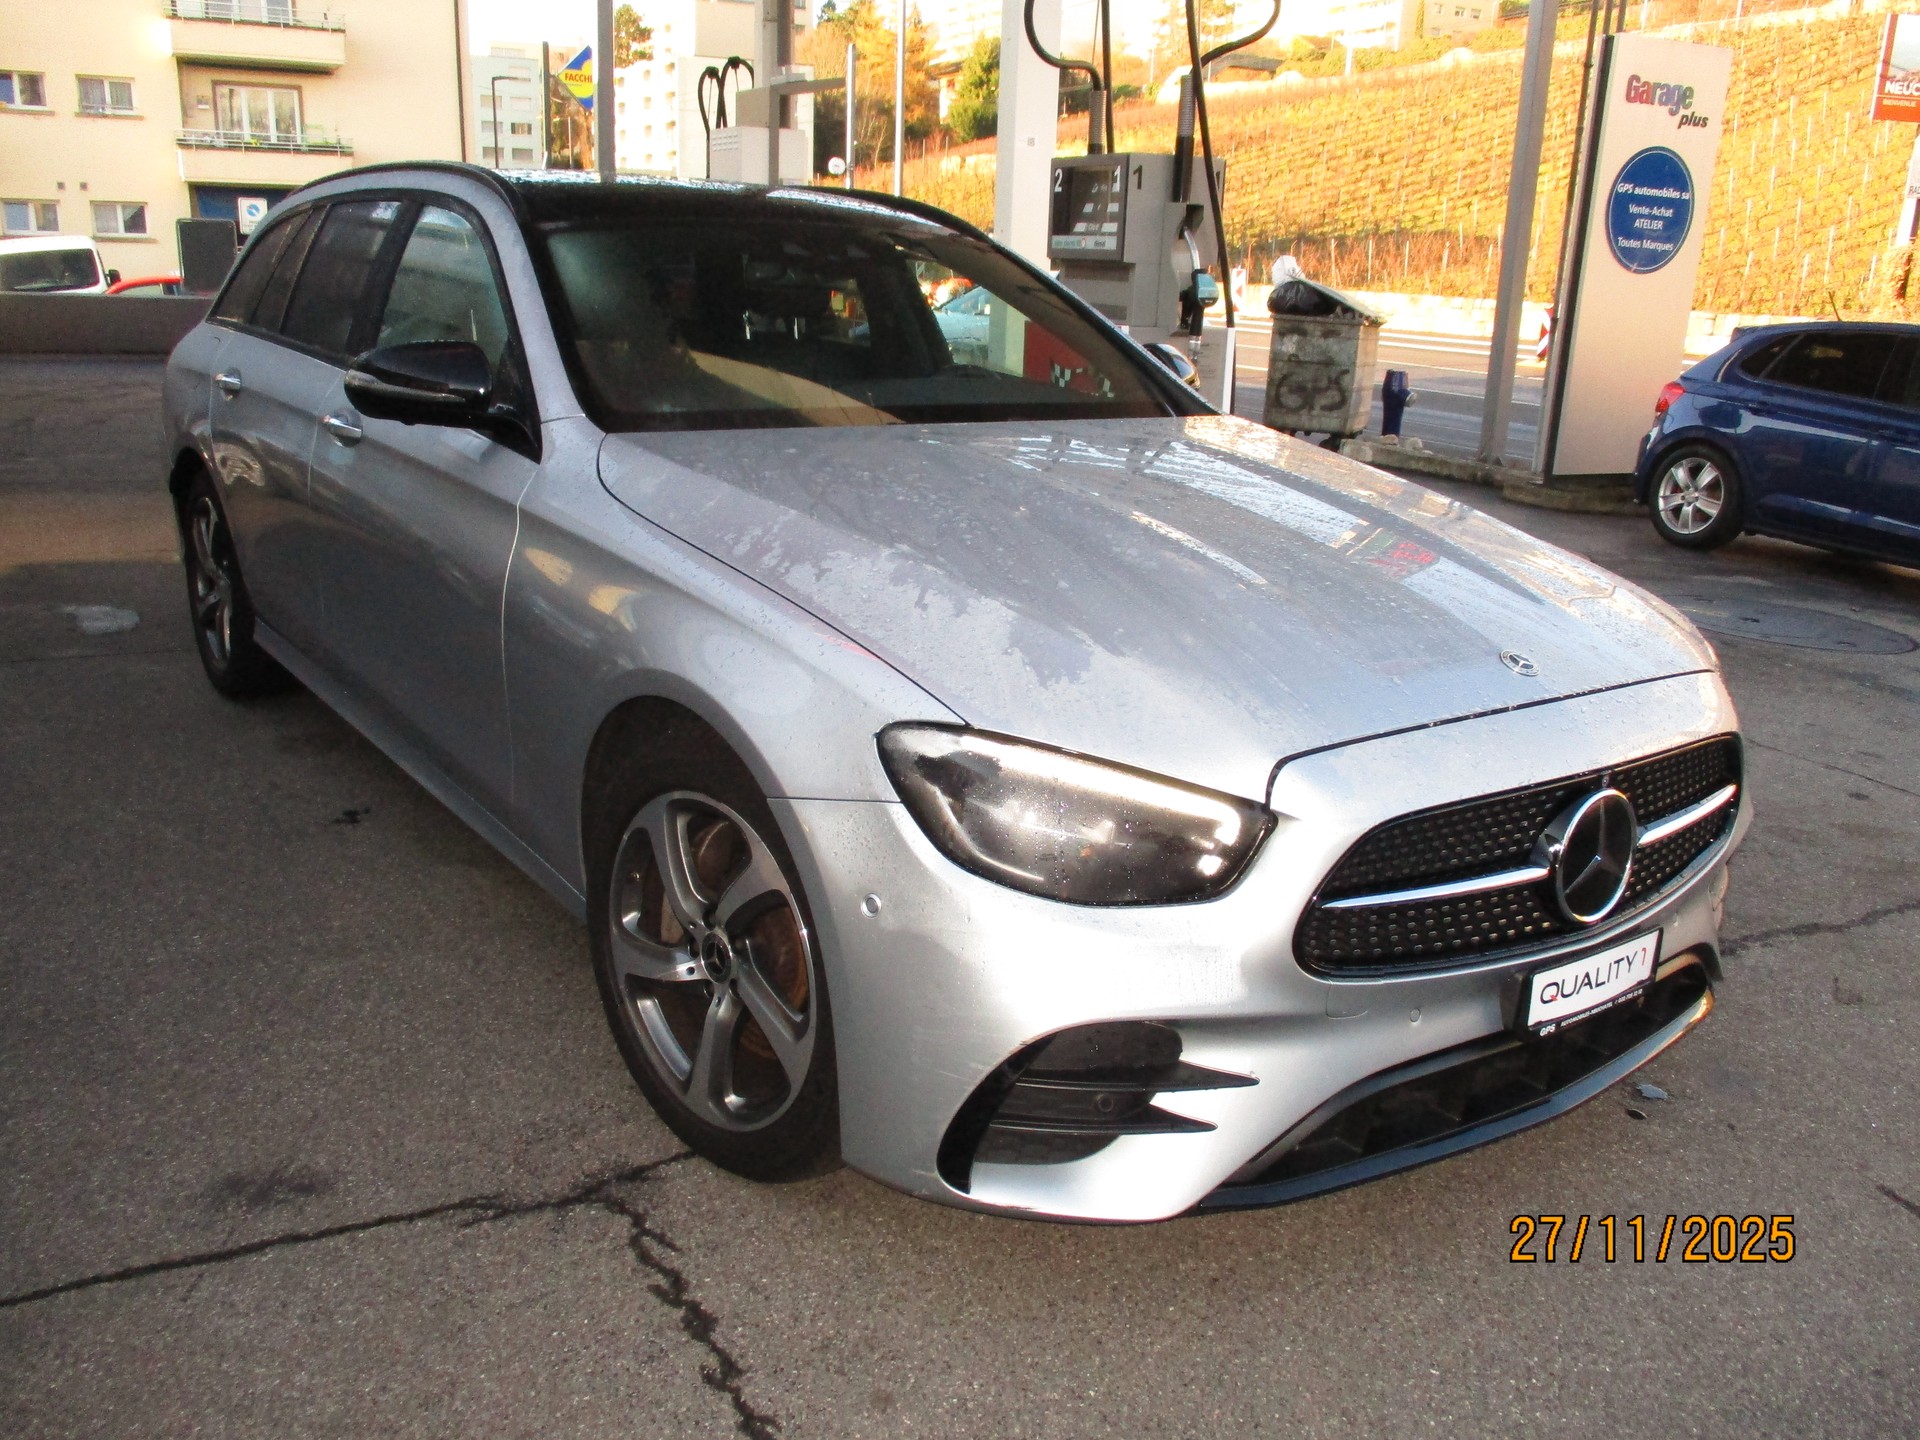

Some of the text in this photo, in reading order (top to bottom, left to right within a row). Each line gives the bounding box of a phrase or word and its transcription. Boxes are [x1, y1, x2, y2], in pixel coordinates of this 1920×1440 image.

[1625, 74, 1694, 116] Garage
[1677, 111, 1709, 129] plus
[1054, 168, 1063, 192] 2
[1112, 165, 1121, 192] 1
[1132, 164, 1143, 190] 1
[1617, 183, 1634, 194] GPS
[1633, 187, 1681, 199] automobiles
[1629, 203, 1673, 217] Vente-Achat
[1633, 218, 1664, 230] ATELIER
[1617, 236, 1674, 252] Toutes Marques
[1539, 951, 1638, 1005] QUALITY
[1539, 1023, 1556, 1037] GPS
